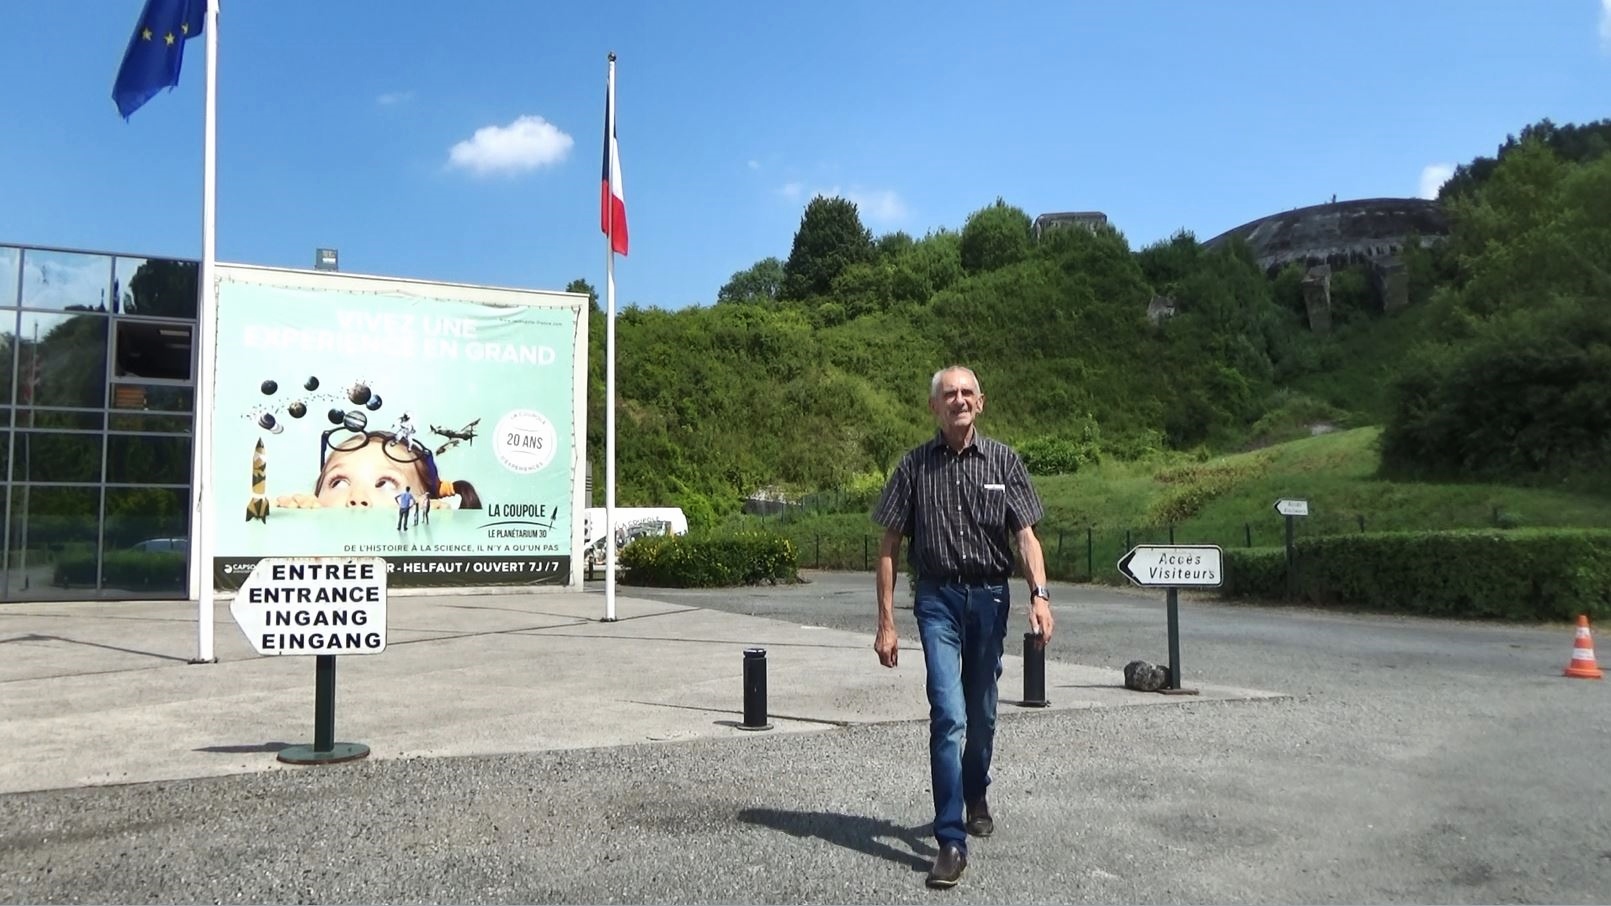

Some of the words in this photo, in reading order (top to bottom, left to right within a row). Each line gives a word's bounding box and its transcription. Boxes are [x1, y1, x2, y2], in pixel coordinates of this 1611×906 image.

[338, 310, 414, 335] VIVEZ
[423, 316, 476, 338] UNE
[423, 337, 458, 359] EN
[465, 341, 556, 366] GRAND
[507, 433, 520, 446] 20
[522, 435, 543, 449] ANS
[488, 504, 500, 517] LA
[503, 504, 546, 517] COUPOLE
[488, 529, 495, 538] LE
[496, 527, 538, 538] PLANÉTARIUM
[538, 529, 547, 538] 3D
[344, 544, 356, 552] DE
[359, 544, 408, 552] L'HISTOIRE
[420, 544, 432, 552] LA
[434, 544, 475, 553] SCIENCE,
[477, 544, 484, 552] IL
[487, 544, 502, 552] N'Y
[504, 544, 510, 552] A
[512, 544, 541, 552] QU'UN
[543, 544, 559, 552] PAS
[1159, 552, 1201, 565] Accès
[272, 560, 374, 580] ENTRÉE
[403, 562, 463, 573] HELFAUT
[473, 561, 525, 572] OUVERT
[1149, 566, 1215, 579] Visiteurs
[249, 586, 379, 603] ENTRANCE
[266, 610, 367, 626] INGANG
[262, 632, 381, 649] EINGANG
